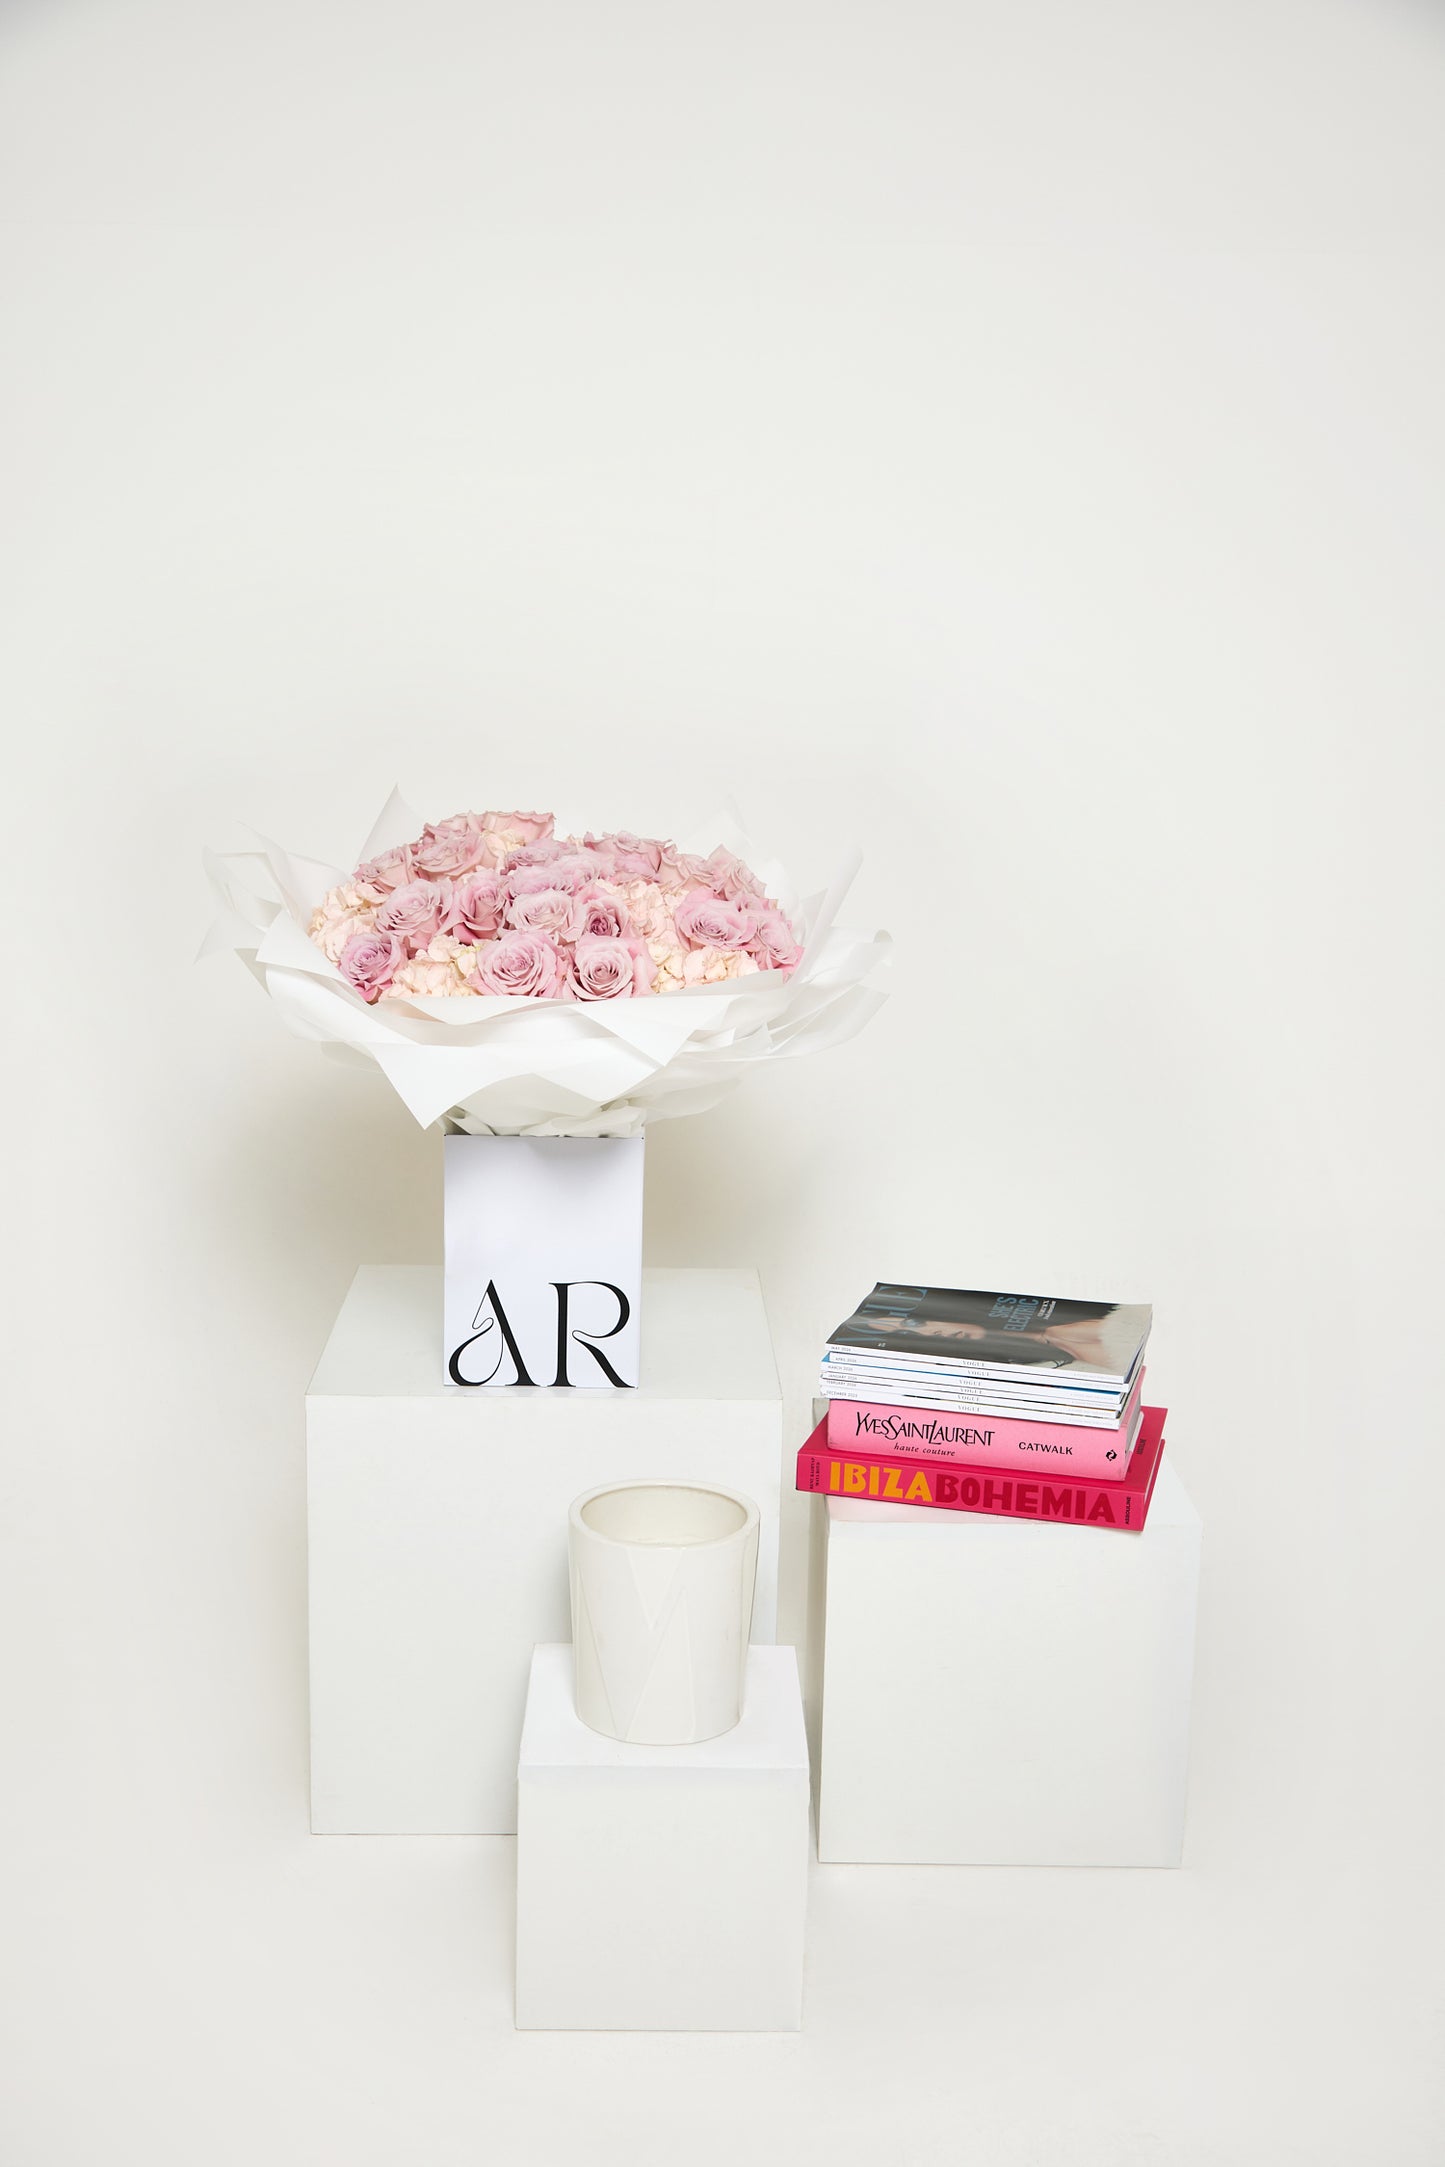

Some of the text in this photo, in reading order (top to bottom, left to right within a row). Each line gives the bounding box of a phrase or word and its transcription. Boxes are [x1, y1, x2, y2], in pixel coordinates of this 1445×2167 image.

[835, 1285, 927, 1342] VOGUE
[988, 1296, 1017, 1318] SHE'S
[1003, 1298, 1039, 1331] ELECTRIC
[448, 1279, 635, 1388] AR
[959, 1379, 982, 1387] VOGUE
[957, 1394, 980, 1402] VOGUE
[893, 1442, 956, 1457] haute couture
[1018, 1441, 1073, 1455] CATWALK
[830, 1461, 1116, 1523] IBIZA BOHEMIA
